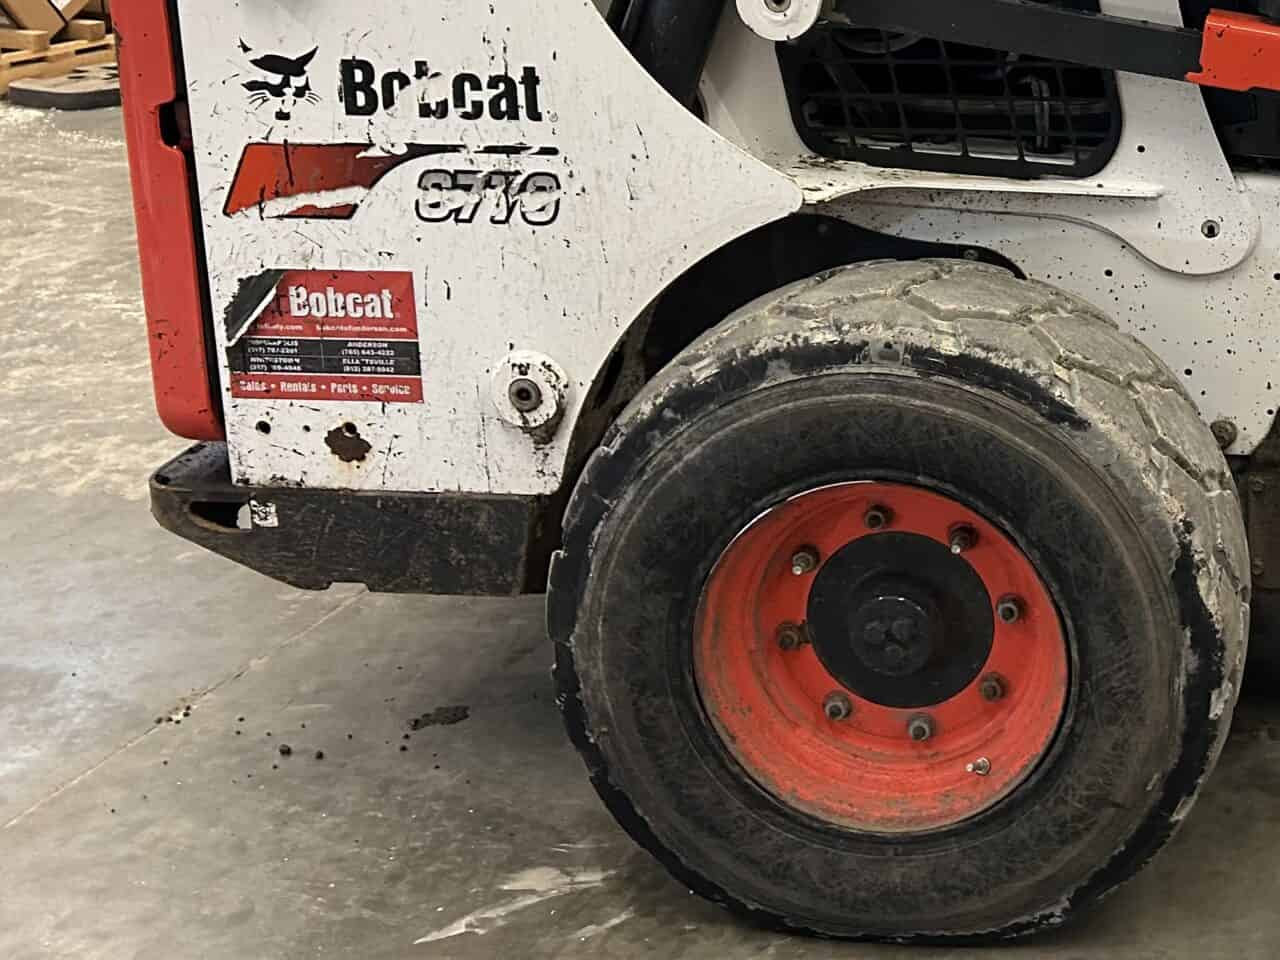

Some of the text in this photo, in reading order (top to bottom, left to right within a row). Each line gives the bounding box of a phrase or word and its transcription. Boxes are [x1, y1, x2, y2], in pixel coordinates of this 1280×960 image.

[287, 285, 395, 319] Bobcat
[280, 381, 317, 393] Rentals
[330, 382, 359, 394] Parts
[371, 383, 411, 395] Service
